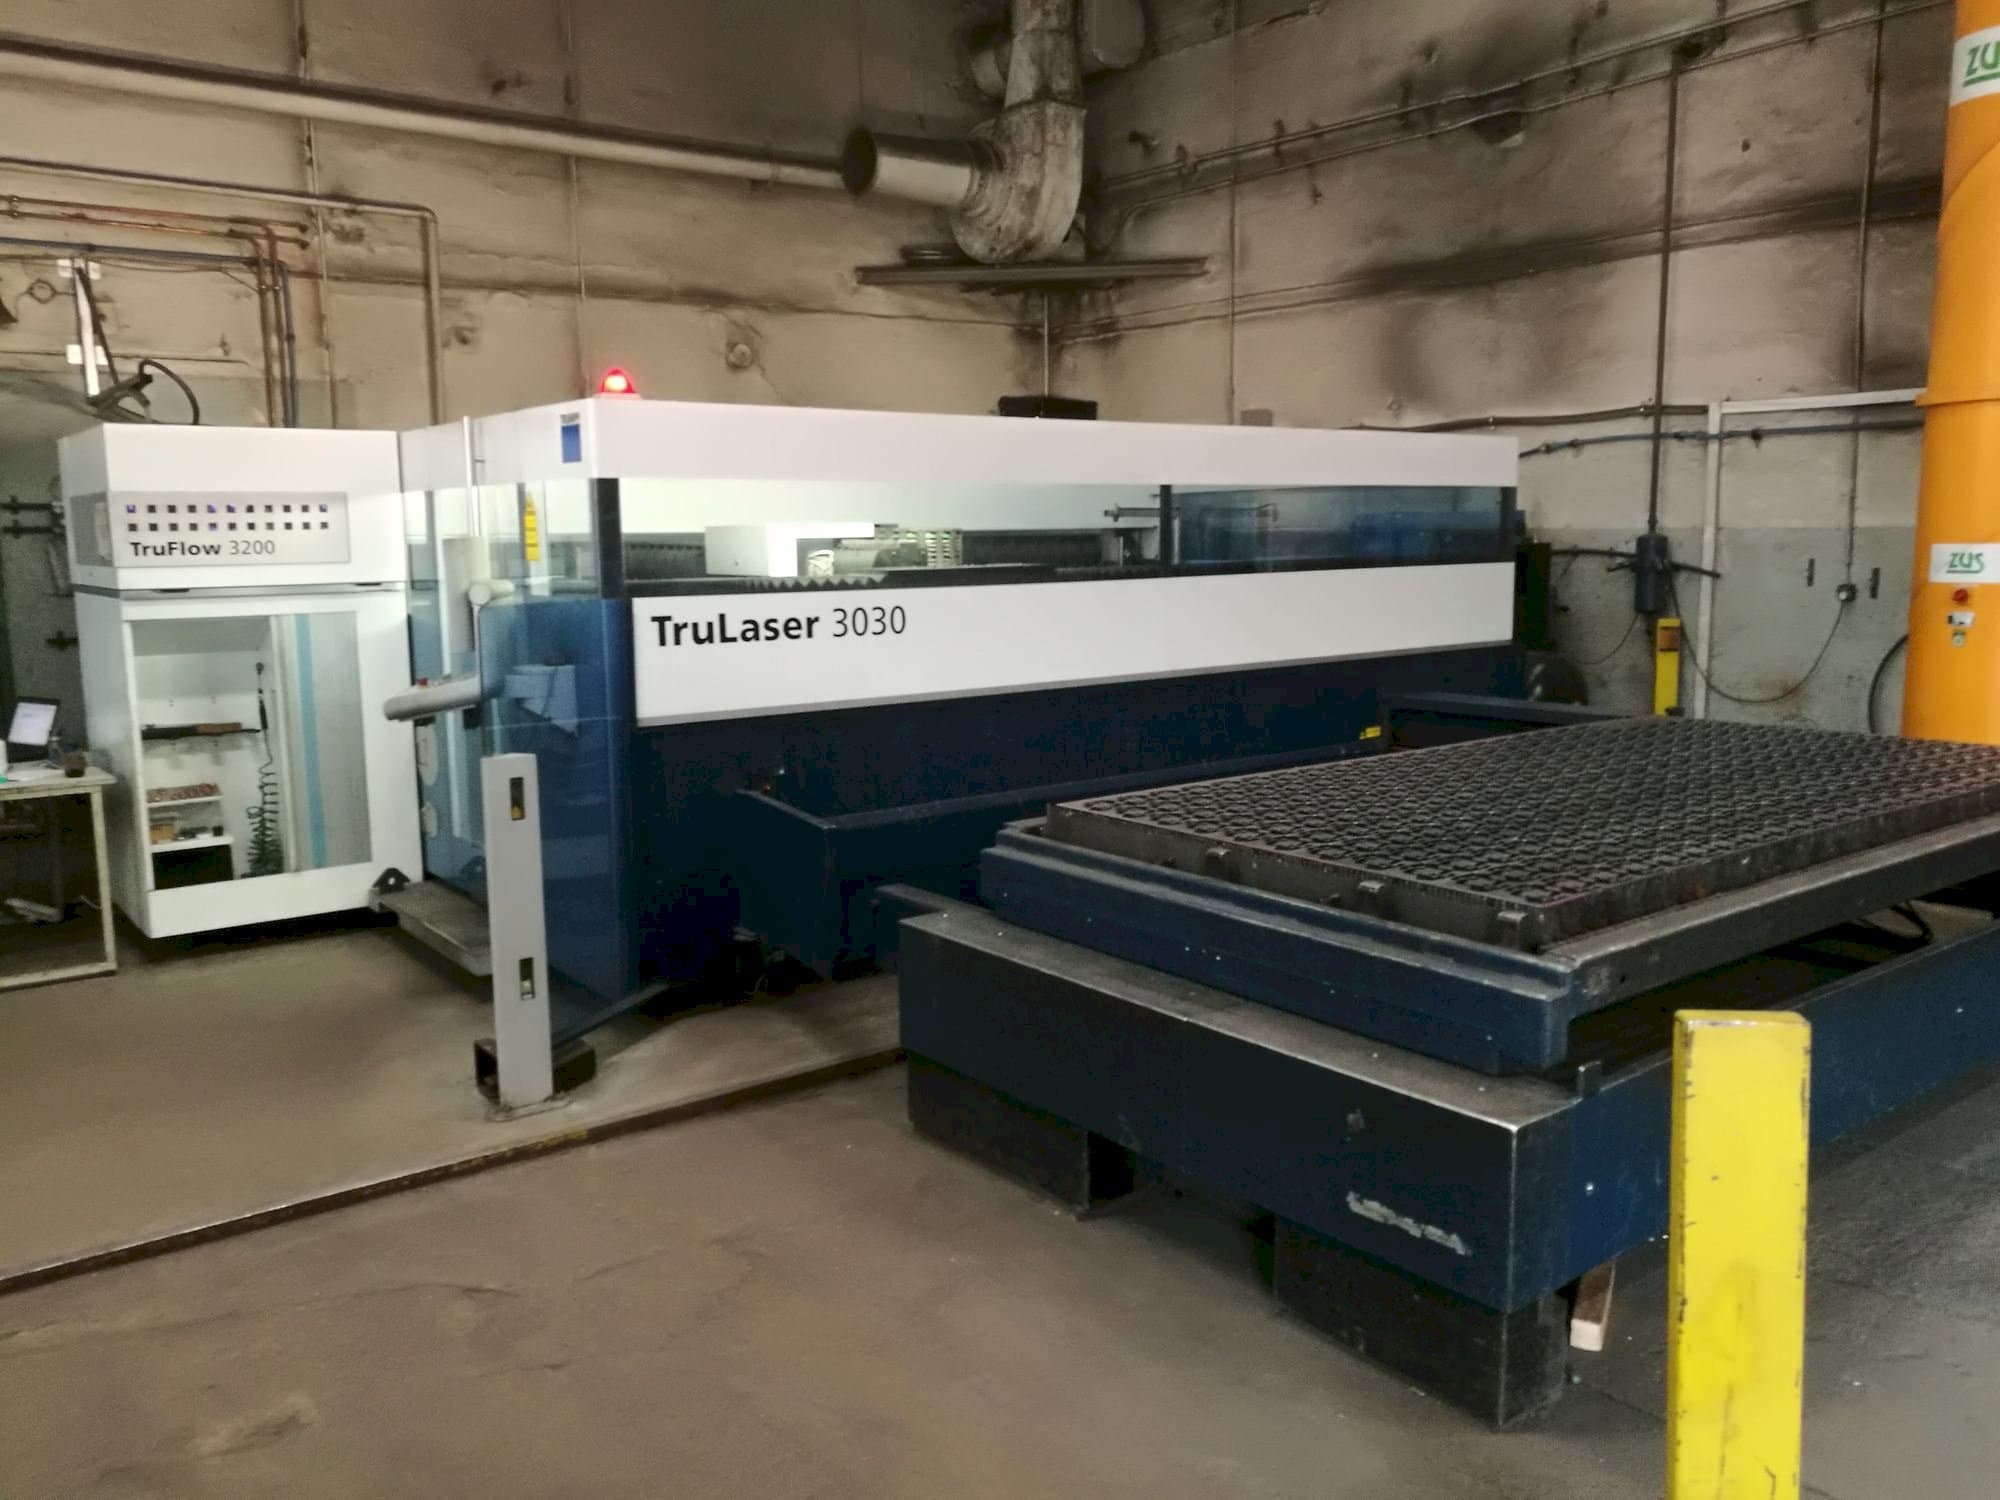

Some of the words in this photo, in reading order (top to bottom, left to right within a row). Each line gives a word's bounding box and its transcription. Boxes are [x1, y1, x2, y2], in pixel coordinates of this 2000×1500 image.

[1963, 41, 2000, 87] ZU
[130, 541, 222, 556] TruFlow
[229, 540, 276, 555] 3200
[651, 613, 820, 647] TruLaser
[832, 605, 907, 638] 3030
